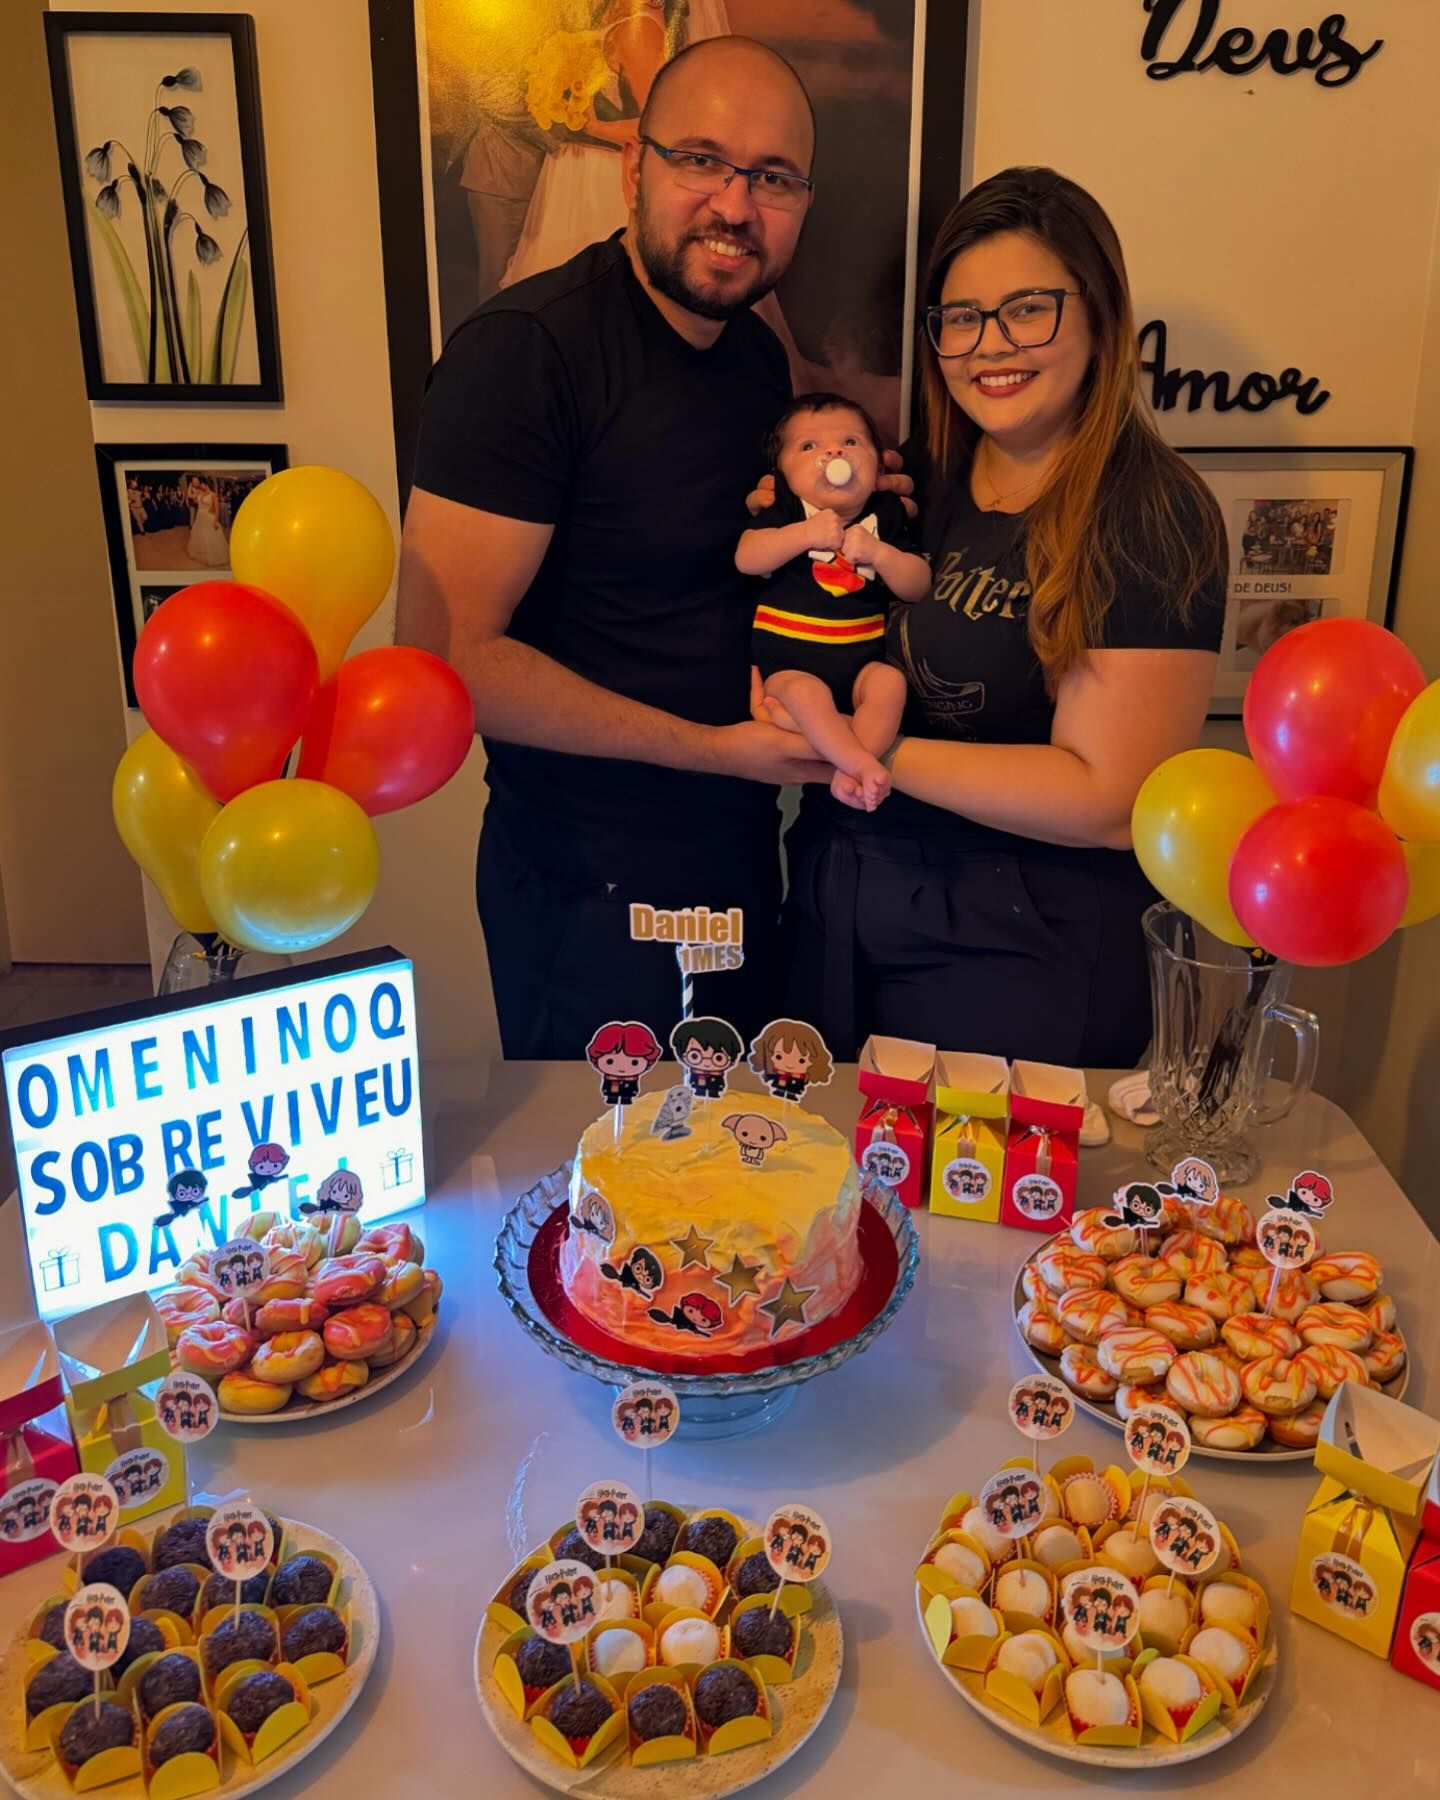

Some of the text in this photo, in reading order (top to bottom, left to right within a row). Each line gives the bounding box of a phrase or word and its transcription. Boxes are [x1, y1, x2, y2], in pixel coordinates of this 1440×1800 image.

[1140, 0, 1385, 87] Deus
[1137, 319, 1331, 415] Amor
[1233, 582, 1292, 593] DE DEUS!
[631, 905, 742, 945] Daniel
